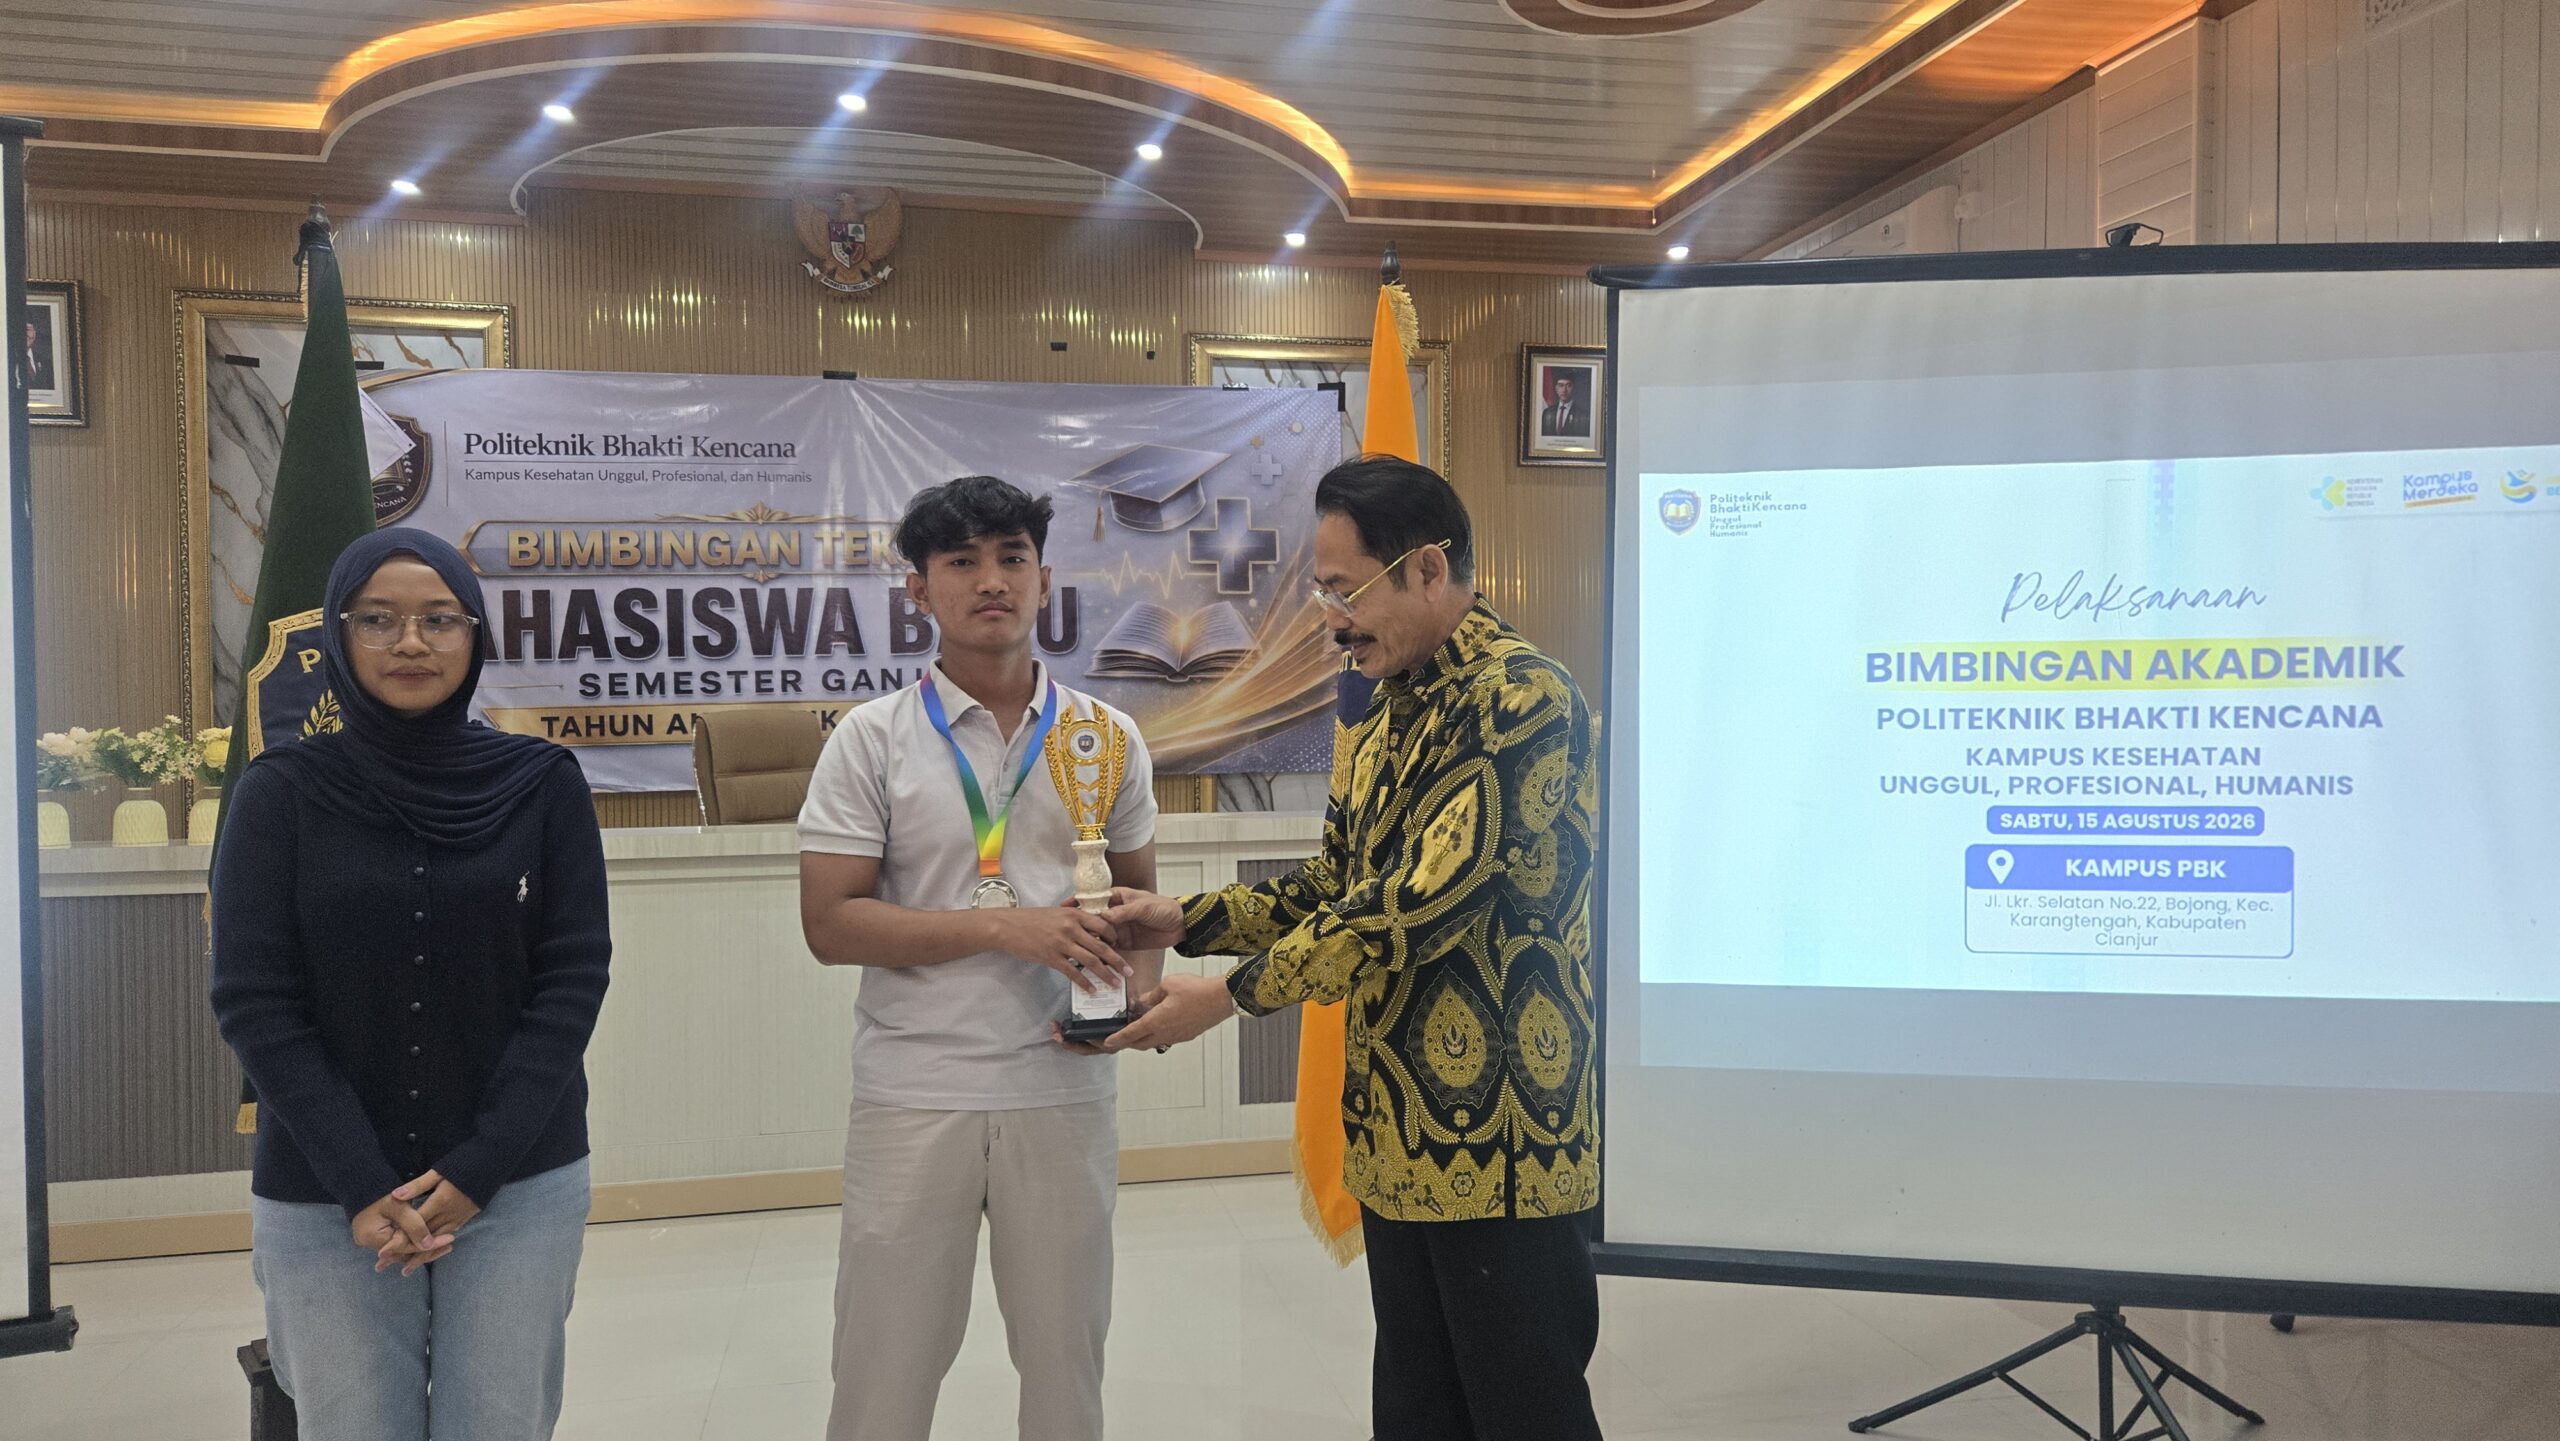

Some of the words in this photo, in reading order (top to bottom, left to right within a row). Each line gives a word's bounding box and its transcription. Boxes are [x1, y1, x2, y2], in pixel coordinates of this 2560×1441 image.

[464, 432, 595, 457] Politeknik
[602, 434, 684, 457] Bhakti
[691, 436, 796, 459] Kencana
[465, 469, 520, 483] Kampus
[524, 468, 594, 482] Kesehatan
[598, 469, 648, 484] Unggul,
[652, 469, 727, 484] Profesional,
[730, 470, 753, 483] dan
[757, 470, 812, 483] Humanis
[2403, 470, 2473, 487] Kampus
[1710, 491, 1772, 503] Politeknik
[2403, 482, 2478, 500] Merdeka
[374, 495, 408, 509] NCANA
[508, 529, 800, 567] BIMBINGAN
[814, 530, 900, 567] TEK
[2000, 569, 2267, 623] Pelaksanaan
[485, 586, 866, 662] HASISWA
[889, 586, 1080, 656] BU
[1867, 650, 2133, 683] BIMBINGAN
[2145, 645, 2406, 681] AKADEMIK
[579, 670, 802, 697] SEMESTER
[822, 668, 922, 691] GAN
[541, 713, 653, 738] TAHUN
[1877, 706, 2065, 730] POLITEKNIK
[2075, 705, 2199, 730] BHAKTI
[2210, 704, 2383, 730] KENCANA
[1966, 747, 2084, 767] KAMPUS
[2093, 747, 2261, 767] KESEHATAN
[1880, 775, 2000, 798] UNGGUL,
[2009, 775, 2206, 798] PROFESIONAL,
[2216, 775, 2354, 796] HUMANIS
[2000, 813, 2072, 831] SABTU,
[2078, 813, 2098, 828] 15
[2103, 813, 2199, 829] AGUSTUS
[2204, 813, 2256, 829] 2026
[2066, 859, 2171, 878] KAMPUS
[2178, 860, 2226, 878] PBK
[1985, 895, 2001, 908] Jl.
[2007, 895, 2032, 909] Lkr.
[2038, 895, 2104, 909] Selatan
[2110, 896, 2161, 912] No.22,
[2166, 896, 2231, 915] Bojong,
[2236, 898, 2274, 912] Kec.
[2010, 913, 2141, 931] Karangtengah,
[2146, 914, 2246, 932] Kabupaten
[2095, 932, 2158, 950] Cianjur
